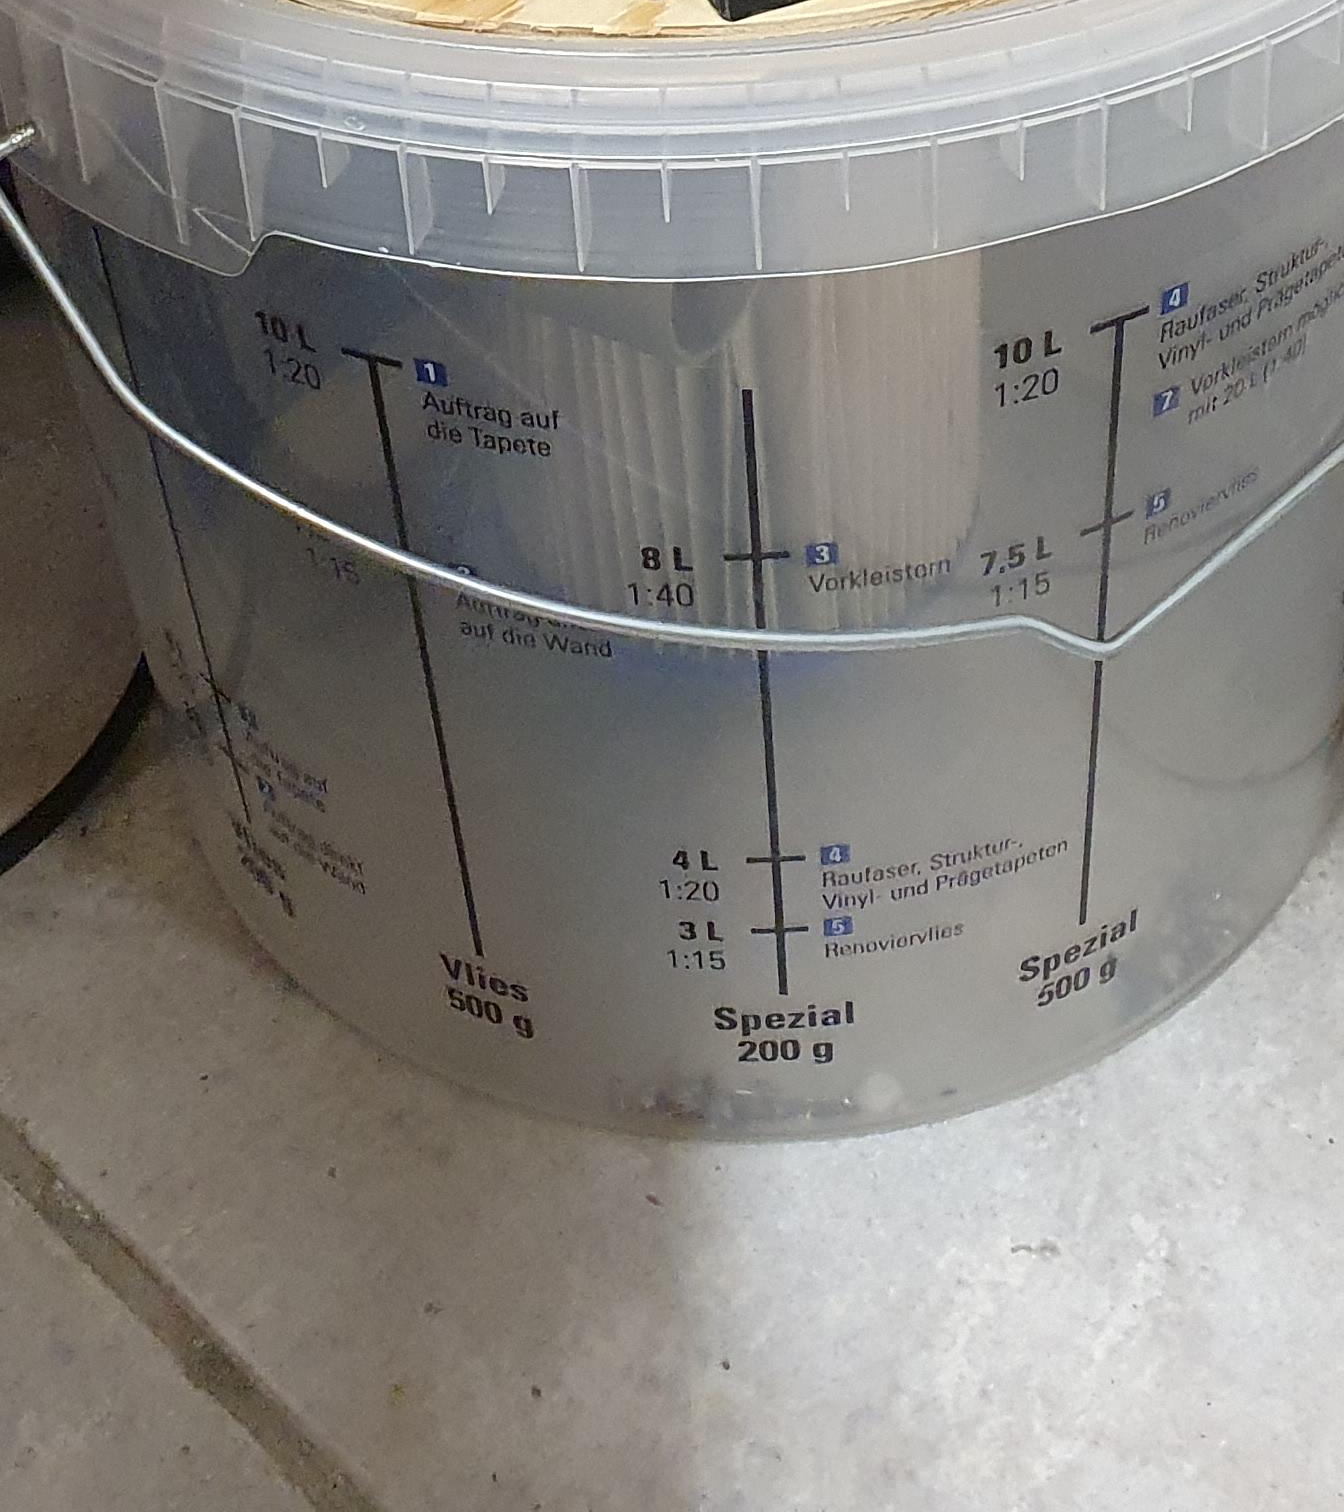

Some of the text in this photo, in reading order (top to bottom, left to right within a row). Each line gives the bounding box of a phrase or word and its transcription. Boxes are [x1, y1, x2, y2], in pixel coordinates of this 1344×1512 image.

[256, 311, 317, 353] 10 L
[994, 330, 1062, 369] 10 L
[1158, 332, 1212, 370] Vinyl-
[1219, 309, 1252, 341] und
[265, 349, 322, 389] 1:20
[994, 367, 1060, 408] 1:20
[422, 390, 560, 431] Auftrag auf
[427, 419, 553, 458] die Tapete
[641, 545, 695, 572] 8 L
[1035, 535, 1053, 561] L
[627, 581, 695, 608] 1:40
[808, 557, 951, 594] Vorkleistern
[990, 571, 1051, 608] 1:15
[460, 620, 613, 658] auf die Wand
[673, 849, 719, 872] 4 L
[821, 859, 922, 889] Raufaser,
[821, 838, 1069, 911] Vinyl- und Prägetapeten
[659, 878, 721, 903] 1:20
[678, 921, 724, 942] 3 L
[824, 922, 966, 960] Renoviervlies
[1018, 909, 1140, 984] Spezial
[439, 951, 529, 1003] Vlies
[667, 949, 727, 972] 1:15
[1036, 956, 1118, 1009] 500 g
[445, 987, 535, 1040] 500 g
[714, 1001, 855, 1037] Spezial
[737, 1040, 835, 1065] 200 g
